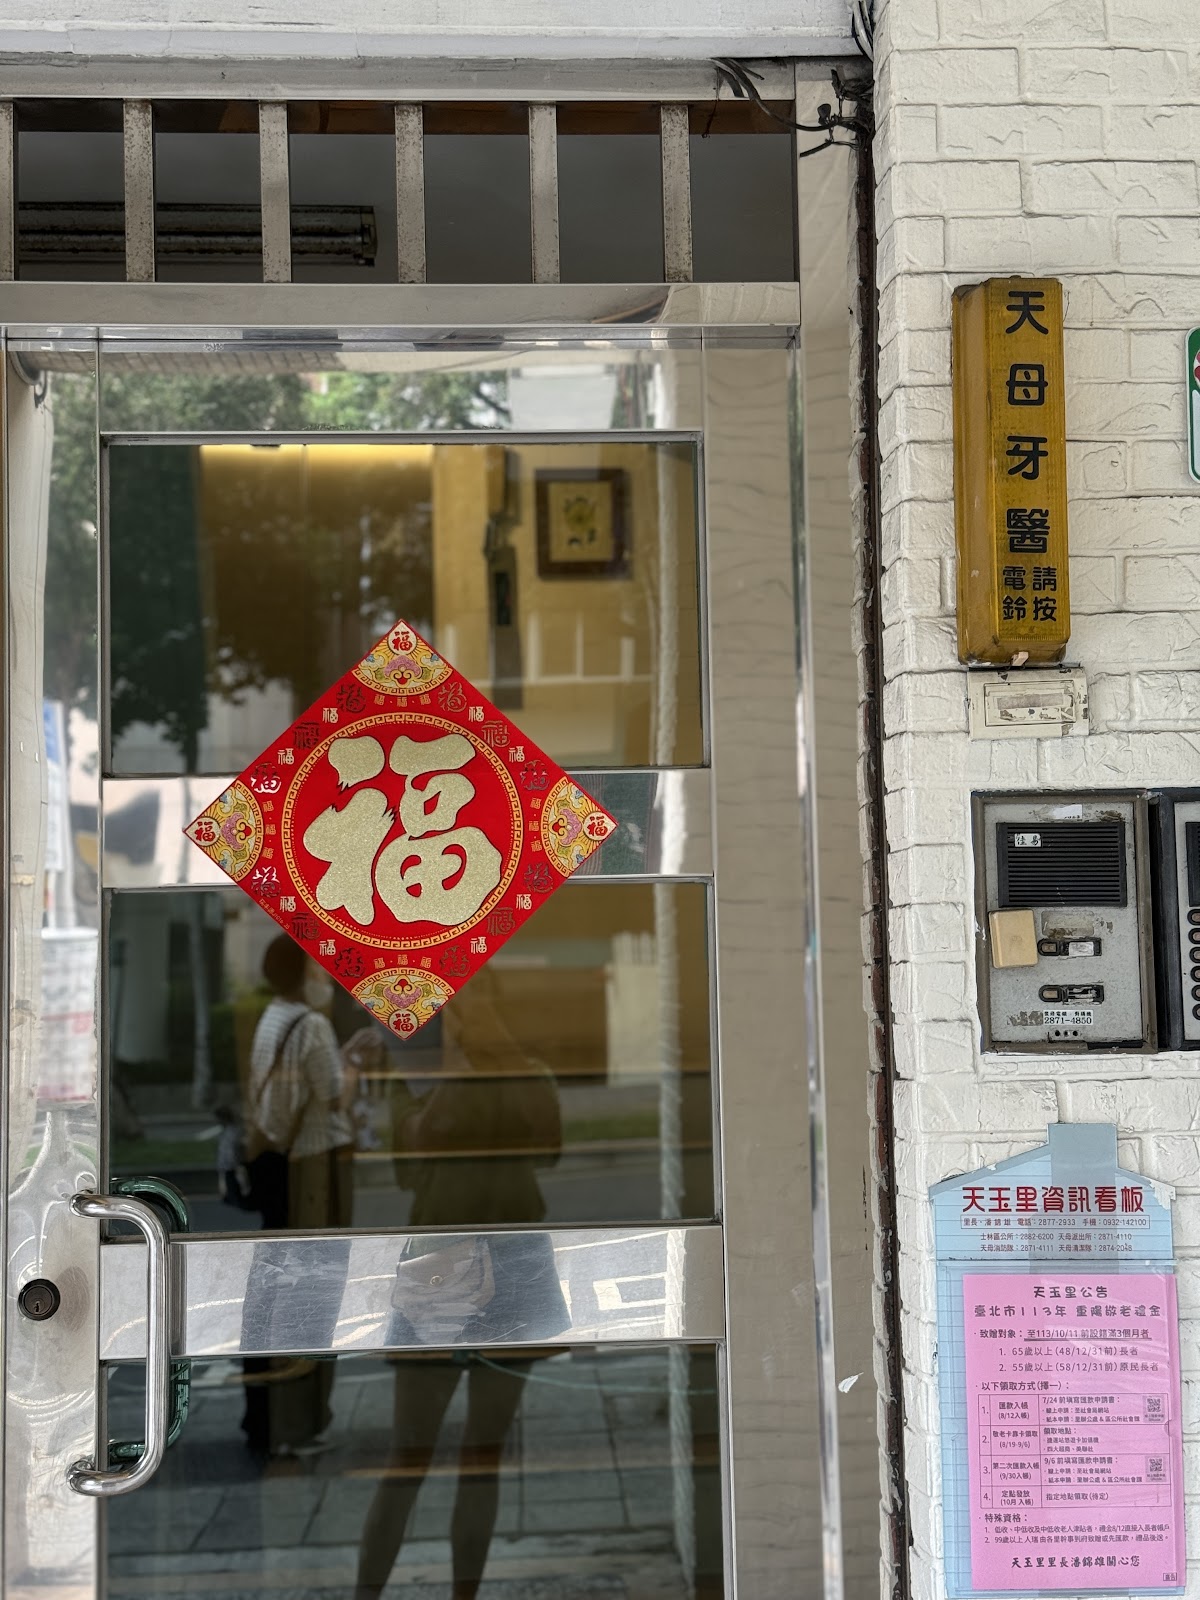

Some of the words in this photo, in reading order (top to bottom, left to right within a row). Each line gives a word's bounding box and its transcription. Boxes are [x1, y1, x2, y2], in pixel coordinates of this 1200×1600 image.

[1005, 290, 1050, 554] 天母牙醫
[1002, 565, 1028, 622] 電鈴
[1032, 565, 1057, 622] 請按
[392, 630, 412, 651] 福
[323, 708, 338, 723] 福
[469, 706, 484, 722] 福
[278, 748, 294, 765] 福
[509, 746, 525, 763] 福
[194, 821, 216, 842] 福
[303, 734, 502, 926] 福
[587, 815, 608, 835] 福
[280, 896, 296, 912] 福
[516, 894, 532, 910] 福
[319, 939, 336, 956] 福
[470, 937, 487, 954] 福
[394, 1013, 414, 1032] 福
[962, 1186, 1144, 1213] 天玉里資訊看板
[1033, 1286, 1108, 1298] 天玉里公告
[1011, 1555, 1140, 1568] 天玉里里長潘錦雄關心您
